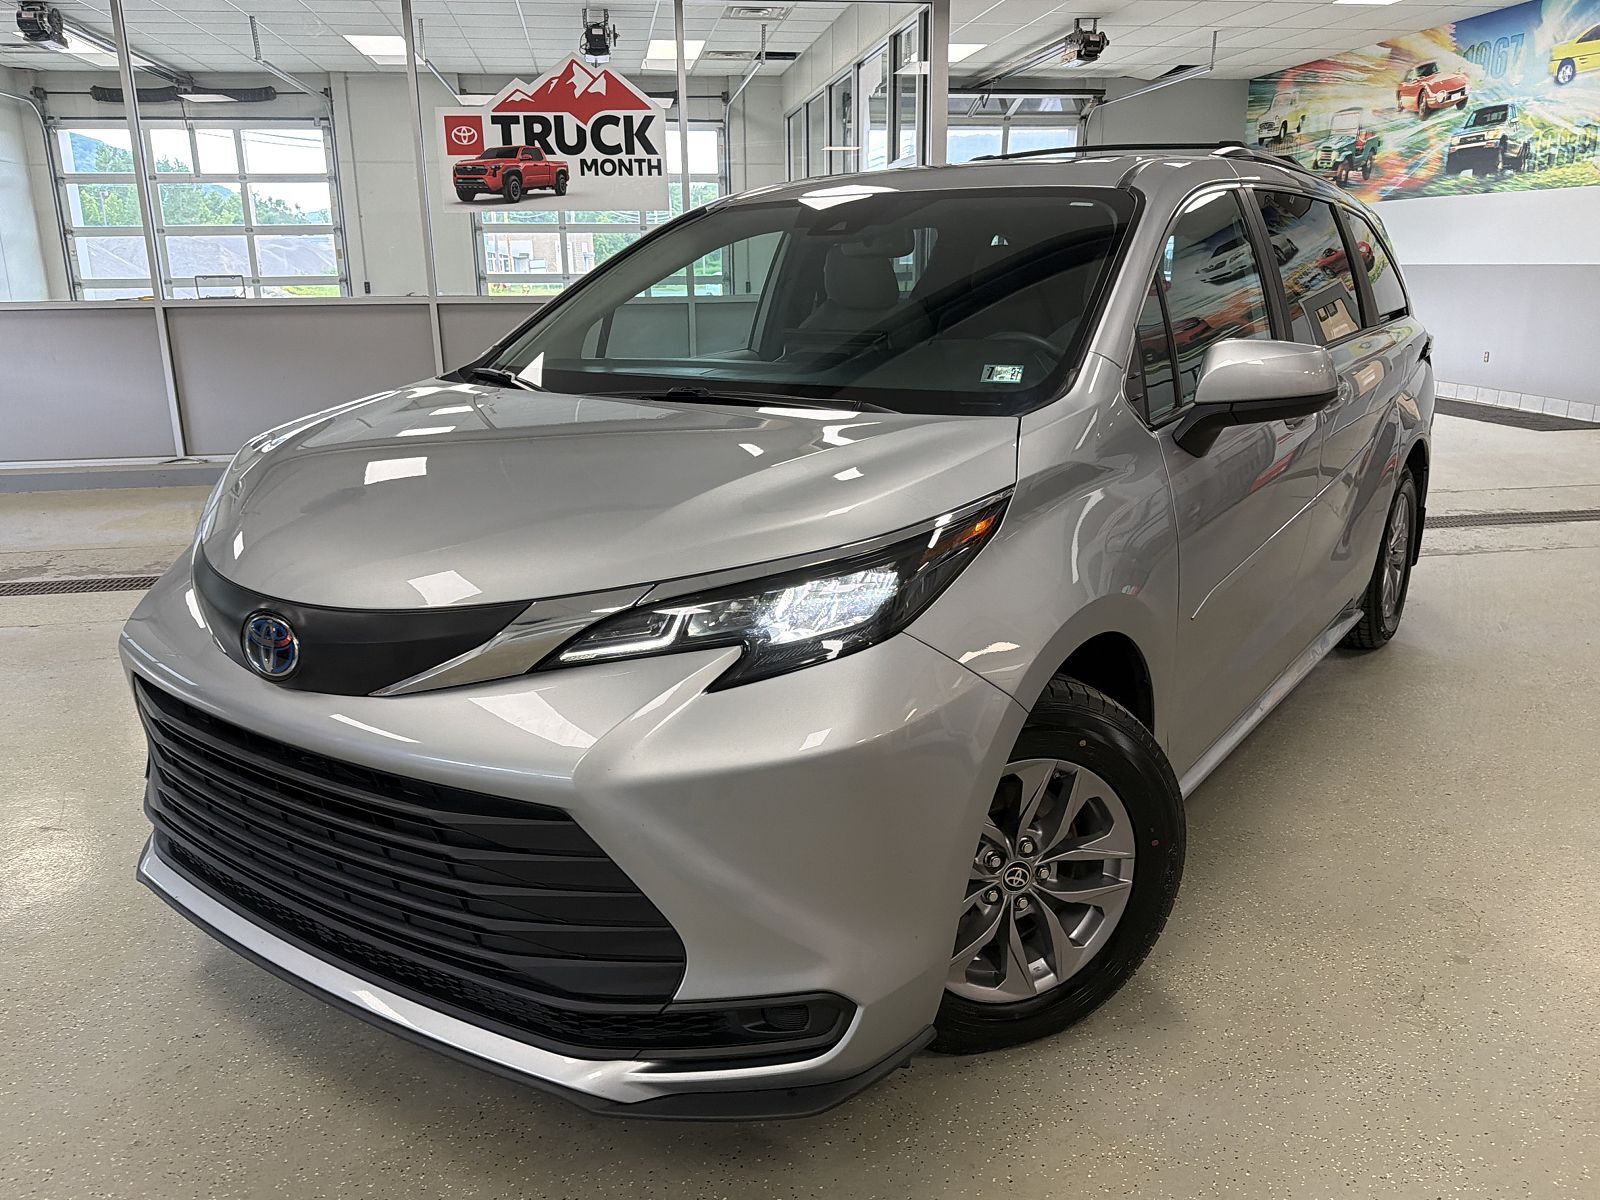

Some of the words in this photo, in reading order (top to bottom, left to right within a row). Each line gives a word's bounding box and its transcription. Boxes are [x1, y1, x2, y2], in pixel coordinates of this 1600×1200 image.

[1463, 33, 1525, 79] 1967
[491, 115, 659, 155] TRUCK
[580, 158, 662, 177] MONTH
